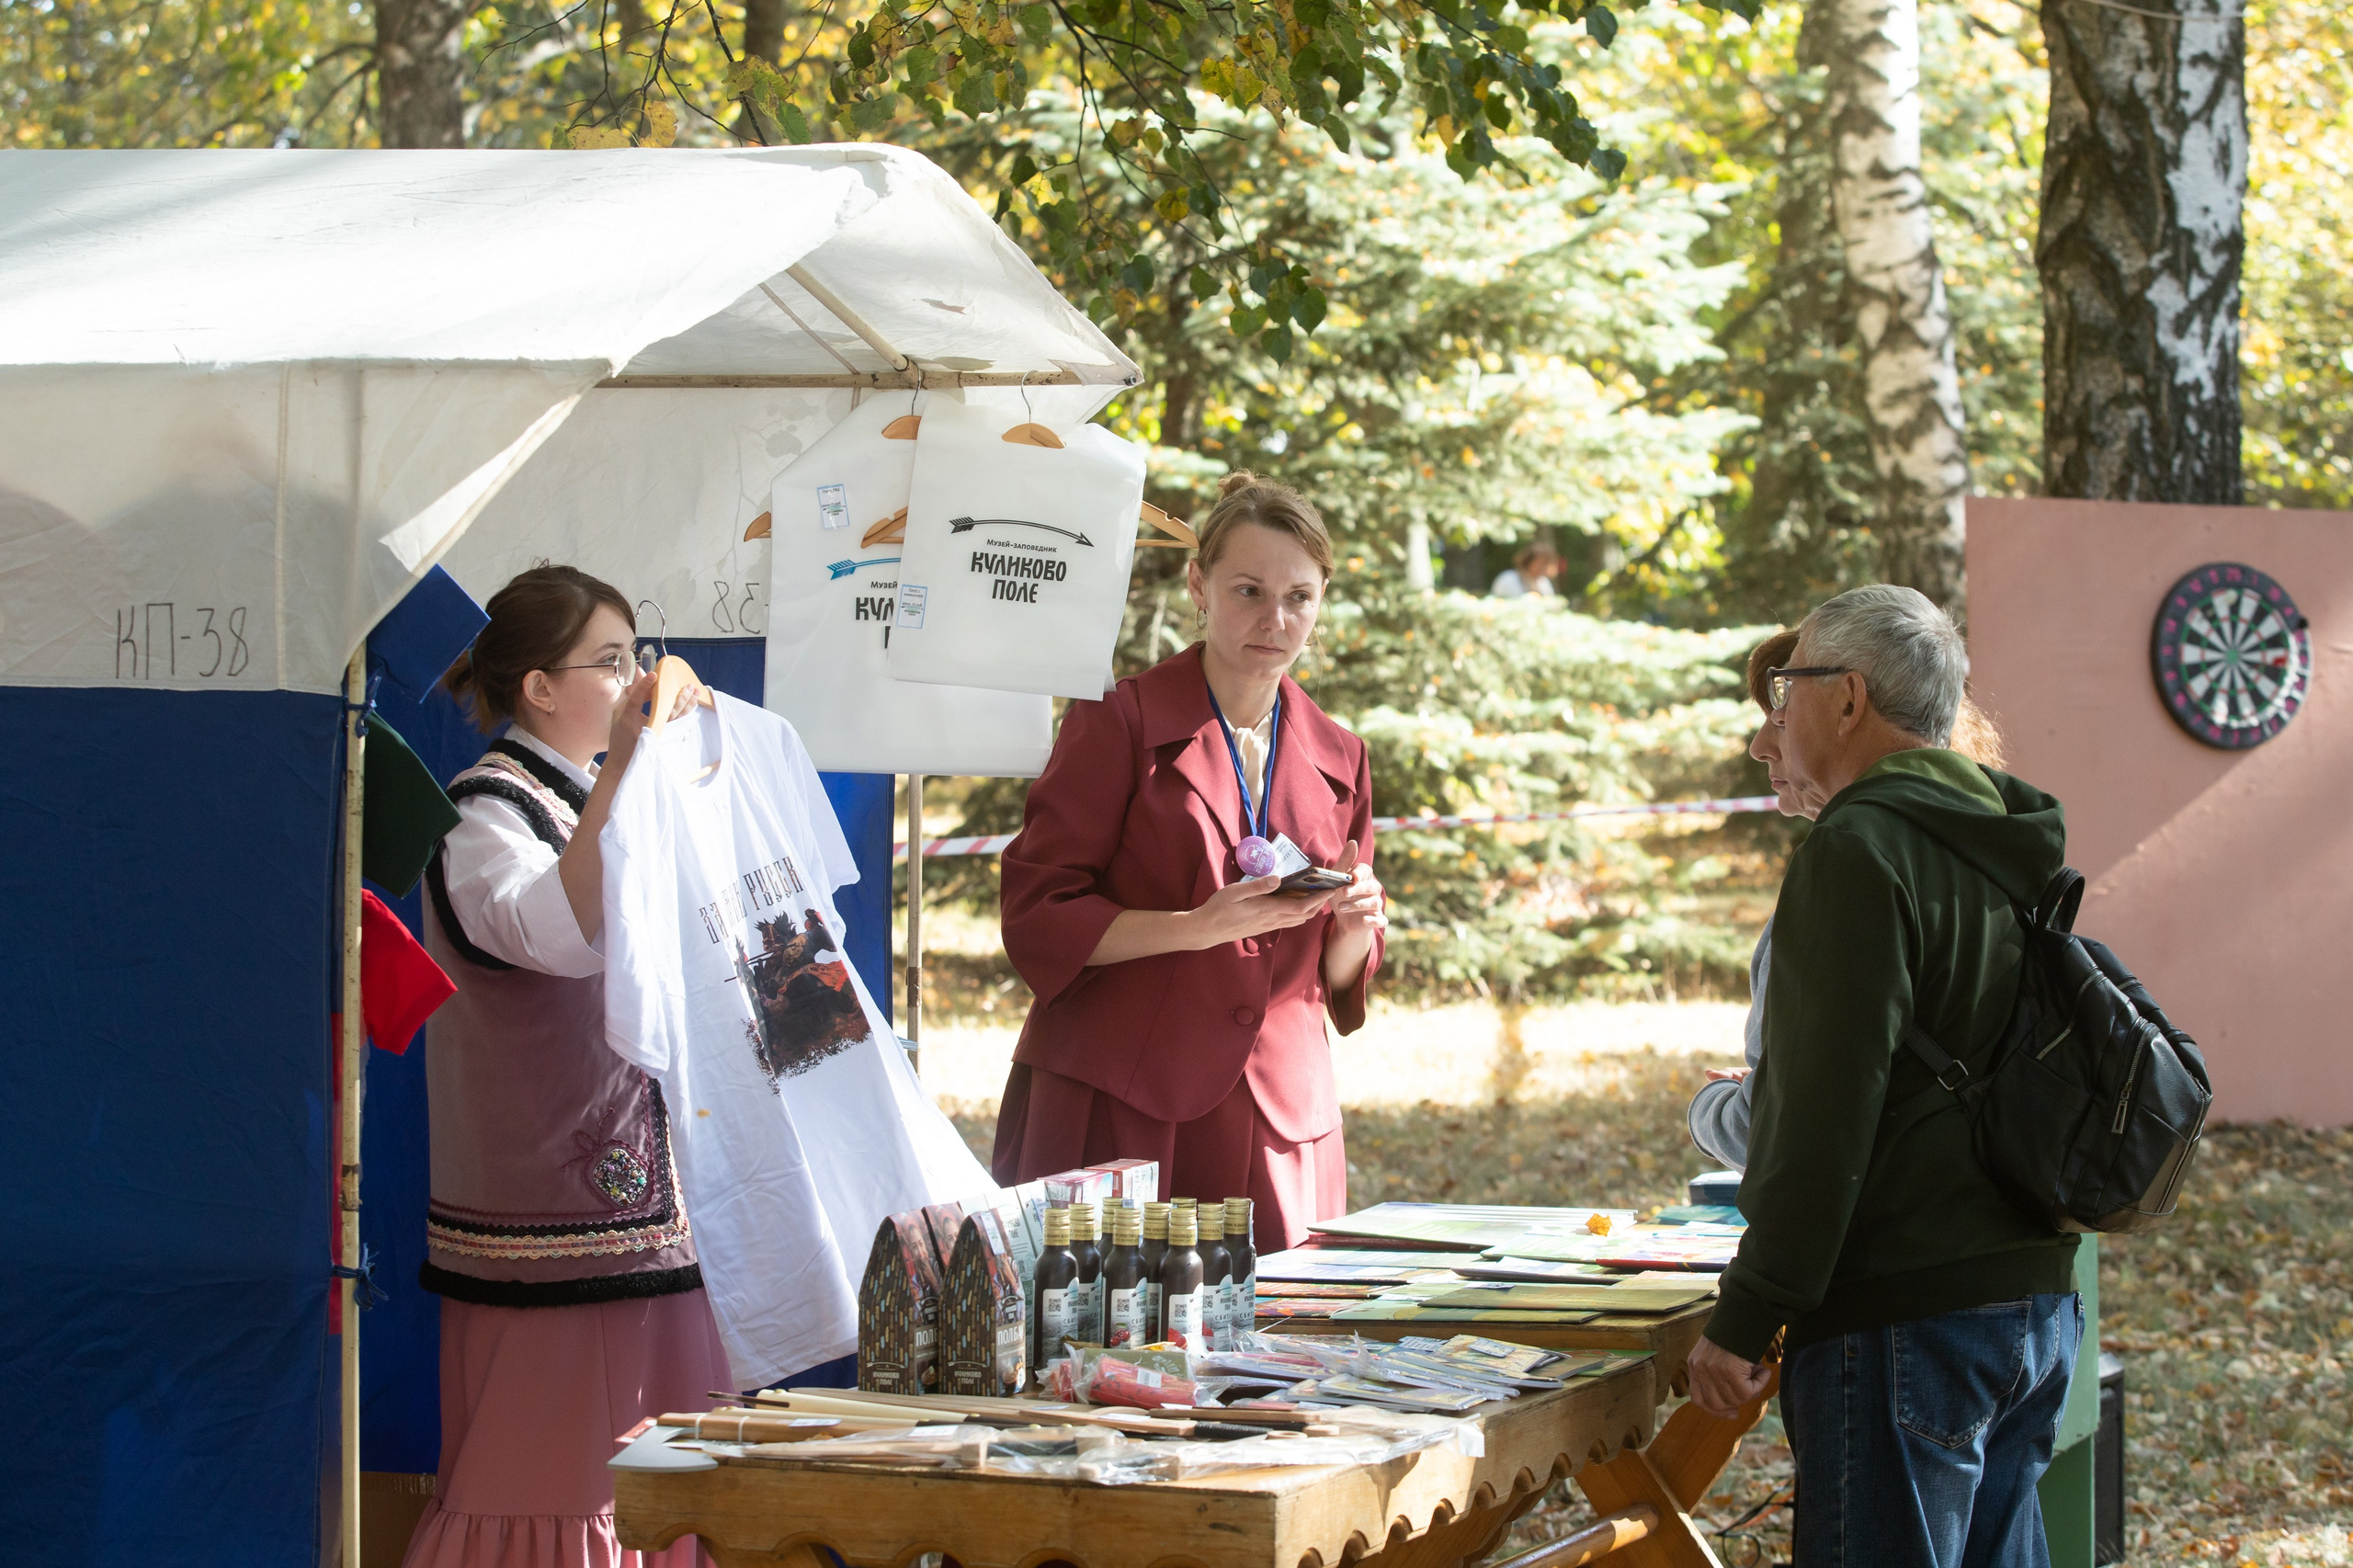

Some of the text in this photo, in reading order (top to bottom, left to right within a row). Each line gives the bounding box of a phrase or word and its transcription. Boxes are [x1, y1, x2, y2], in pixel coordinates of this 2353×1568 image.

[971, 551, 1067, 582] КУЛИКОВО
[992, 579, 1039, 603] ПОЛЕ
[116, 603, 249, 679] КП-38
